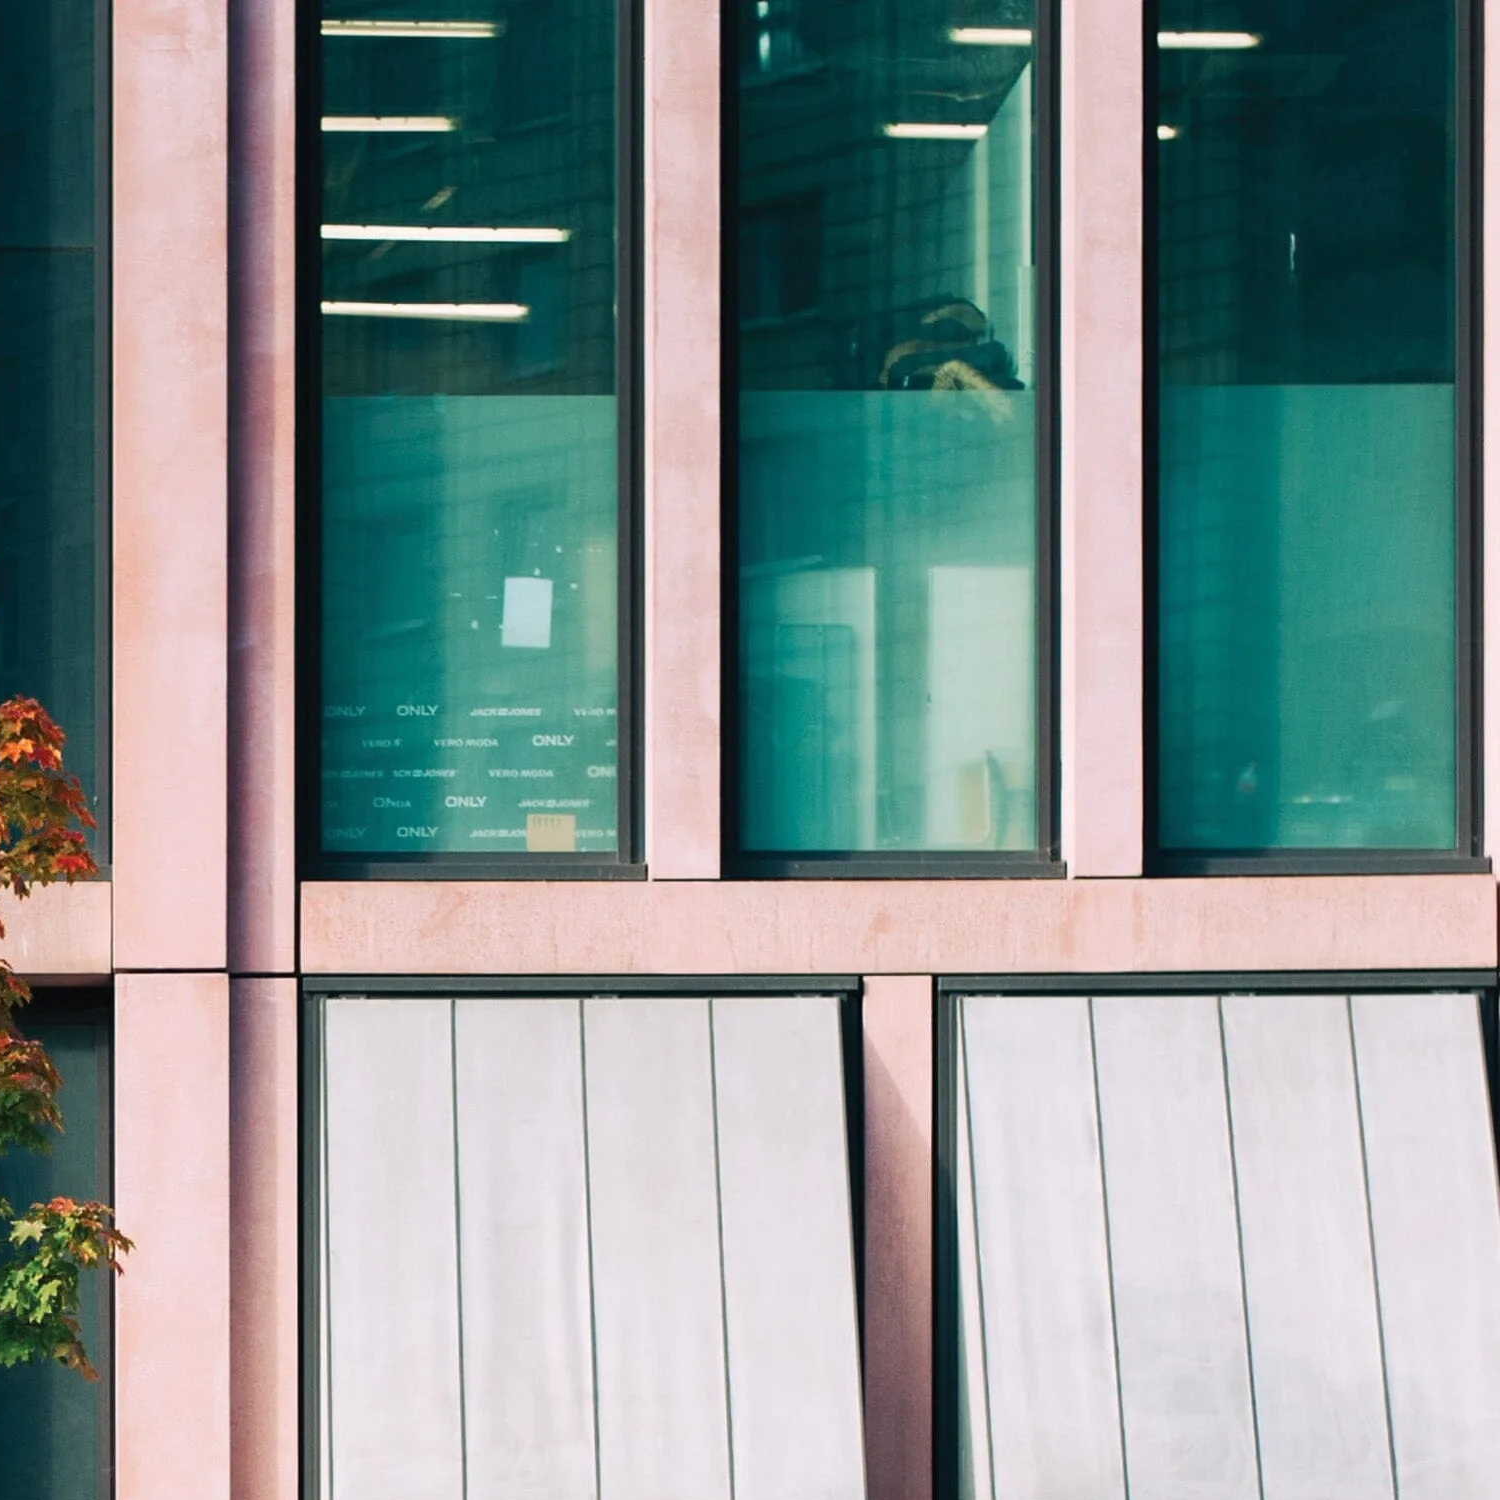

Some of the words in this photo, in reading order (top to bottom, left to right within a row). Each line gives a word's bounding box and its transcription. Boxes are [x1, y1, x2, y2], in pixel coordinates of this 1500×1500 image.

[324, 705, 366, 717] ONLY
[396, 704, 439, 717] ONLY
[433, 738, 463, 748] VERO
[465, 738, 499, 748] MODA
[531, 734, 574, 747] ONLY
[488, 769, 519, 778] VERO
[520, 769, 554, 778] MODA
[444, 795, 487, 808] ONLY
[396, 826, 439, 838] ONLY
